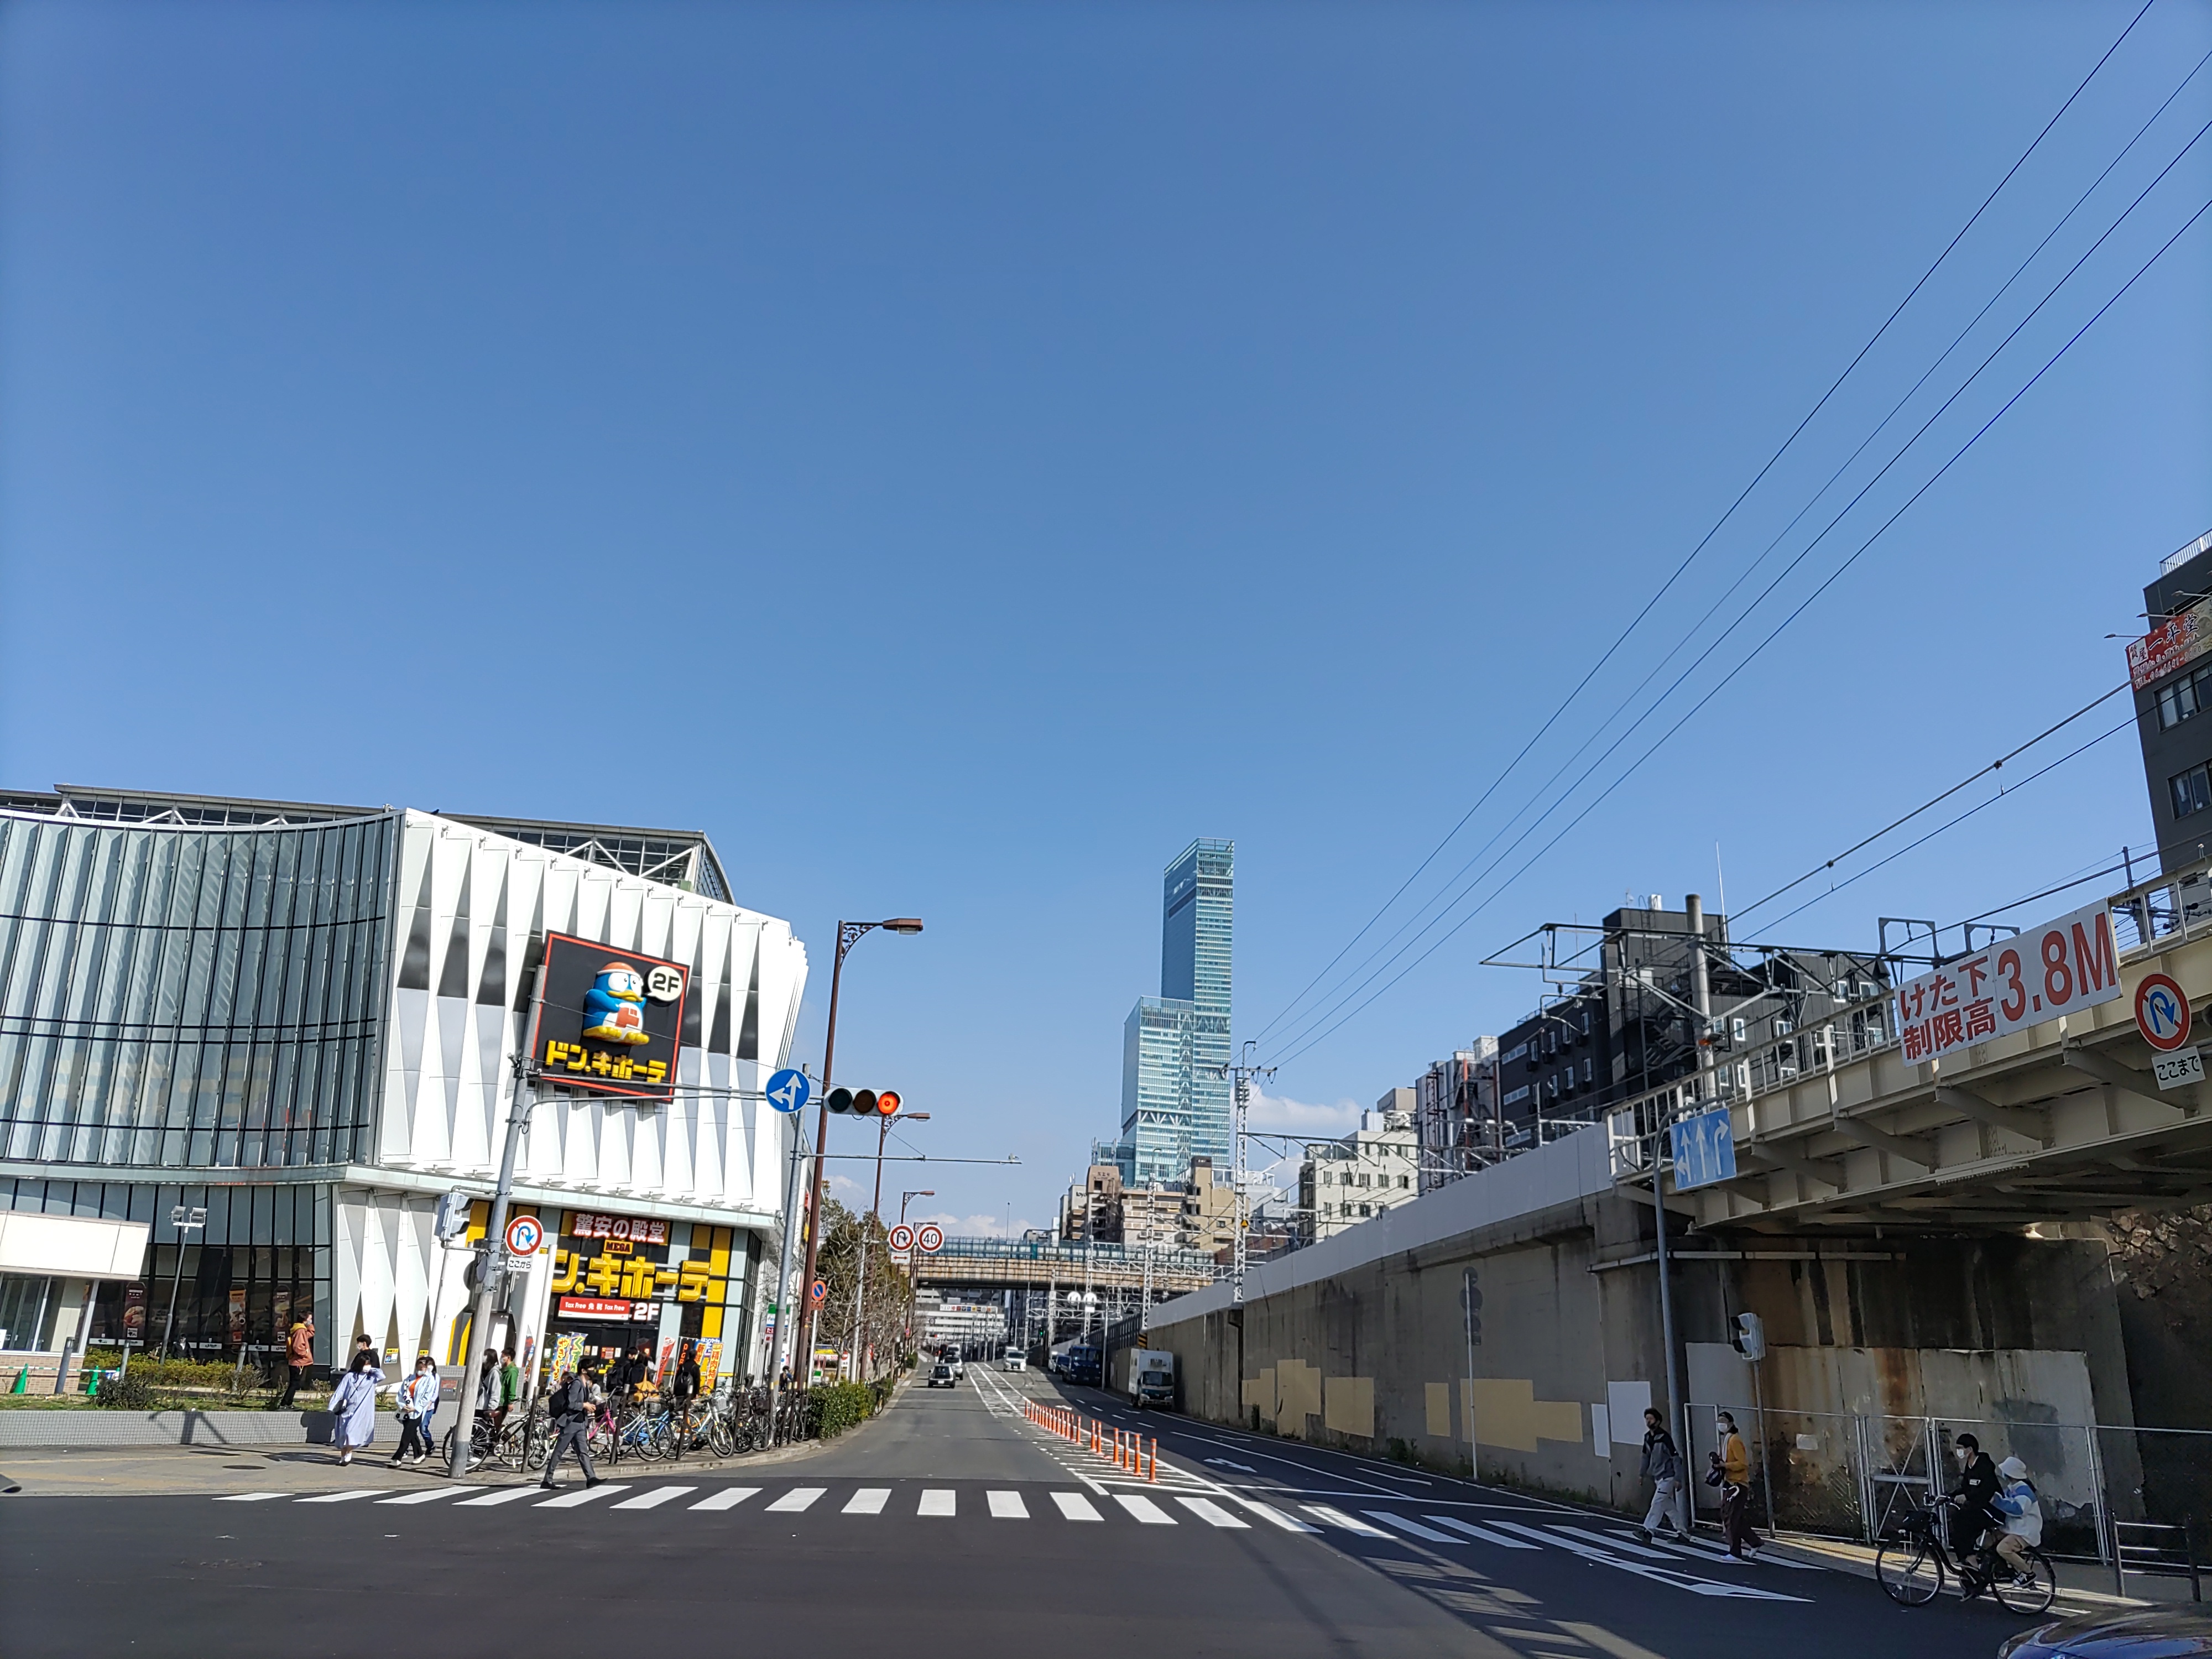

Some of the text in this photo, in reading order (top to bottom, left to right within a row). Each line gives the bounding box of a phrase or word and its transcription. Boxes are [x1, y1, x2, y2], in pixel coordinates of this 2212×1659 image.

[2148, 613, 2200, 650] 一平堂
[1997, 912, 2116, 1022] 3.8M
[653, 972, 680, 993] 2F
[1900, 955, 1989, 1021] けた下
[1903, 995, 1996, 1060] 制限高
[2156, 1056, 2200, 1081] ここまで
[573, 1213, 665, 1243] 驚安の殿堂
[923, 1233, 937, 1244] 40
[606, 1241, 631, 1253] MEGA
[508, 1260, 531, 1269] ここから
[633, 1302, 660, 1321] 2F
